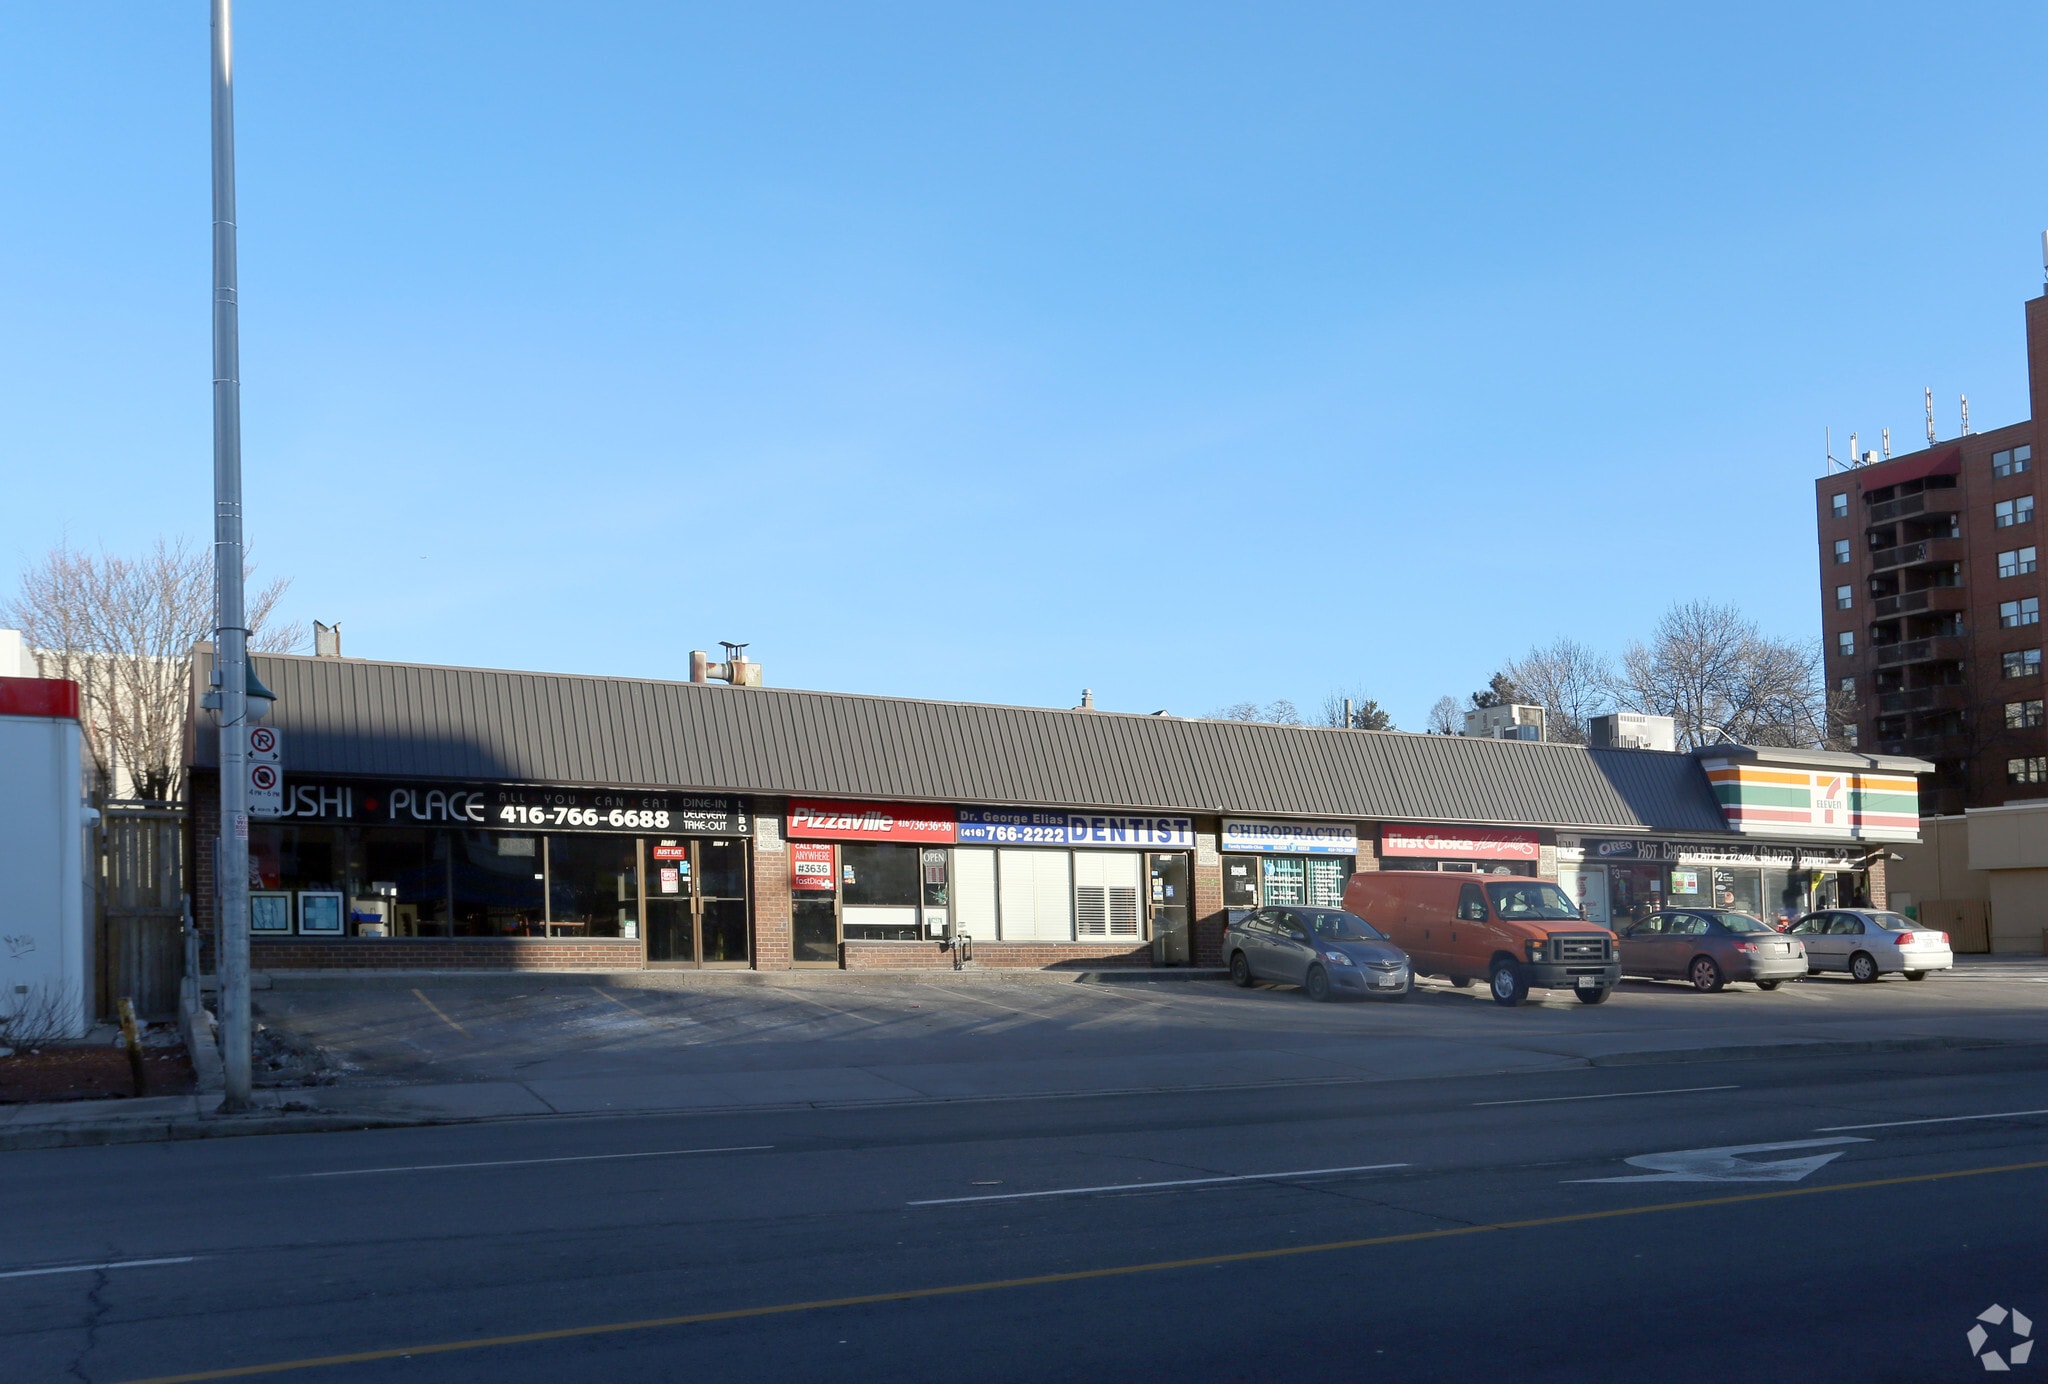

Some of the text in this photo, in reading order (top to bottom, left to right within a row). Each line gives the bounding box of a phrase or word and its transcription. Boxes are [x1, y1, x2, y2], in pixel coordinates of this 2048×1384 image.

[282, 785, 485, 822] USHI PLACE
[499, 792, 669, 809] ALL YOU CAN EAT
[683, 798, 727, 809] DINE-IN
[500, 805, 670, 829] 416-766-6688
[683, 820, 727, 831] TAKE-OUT
[792, 807, 893, 832] Pizzaville
[960, 810, 1064, 825] Dr. George Elias
[960, 826, 1064, 843] (416) 766-2222
[1071, 816, 1189, 843] DENTIST
[1227, 823, 1353, 843] CHIROPRACTIC
[1388, 833, 1534, 855] First Choice Hair Cutters
[795, 850, 830, 861] ANYWHERE
[924, 852, 945, 862] OPEN
[1599, 841, 1632, 855] OREO
[1637, 841, 1658, 859] HOT
[1663, 841, 1716, 861] CHOCOLATE
[1760, 845, 1794, 864] GLAZED
[1796, 847, 1827, 865] DONUT
[798, 864, 828, 873] #3636
